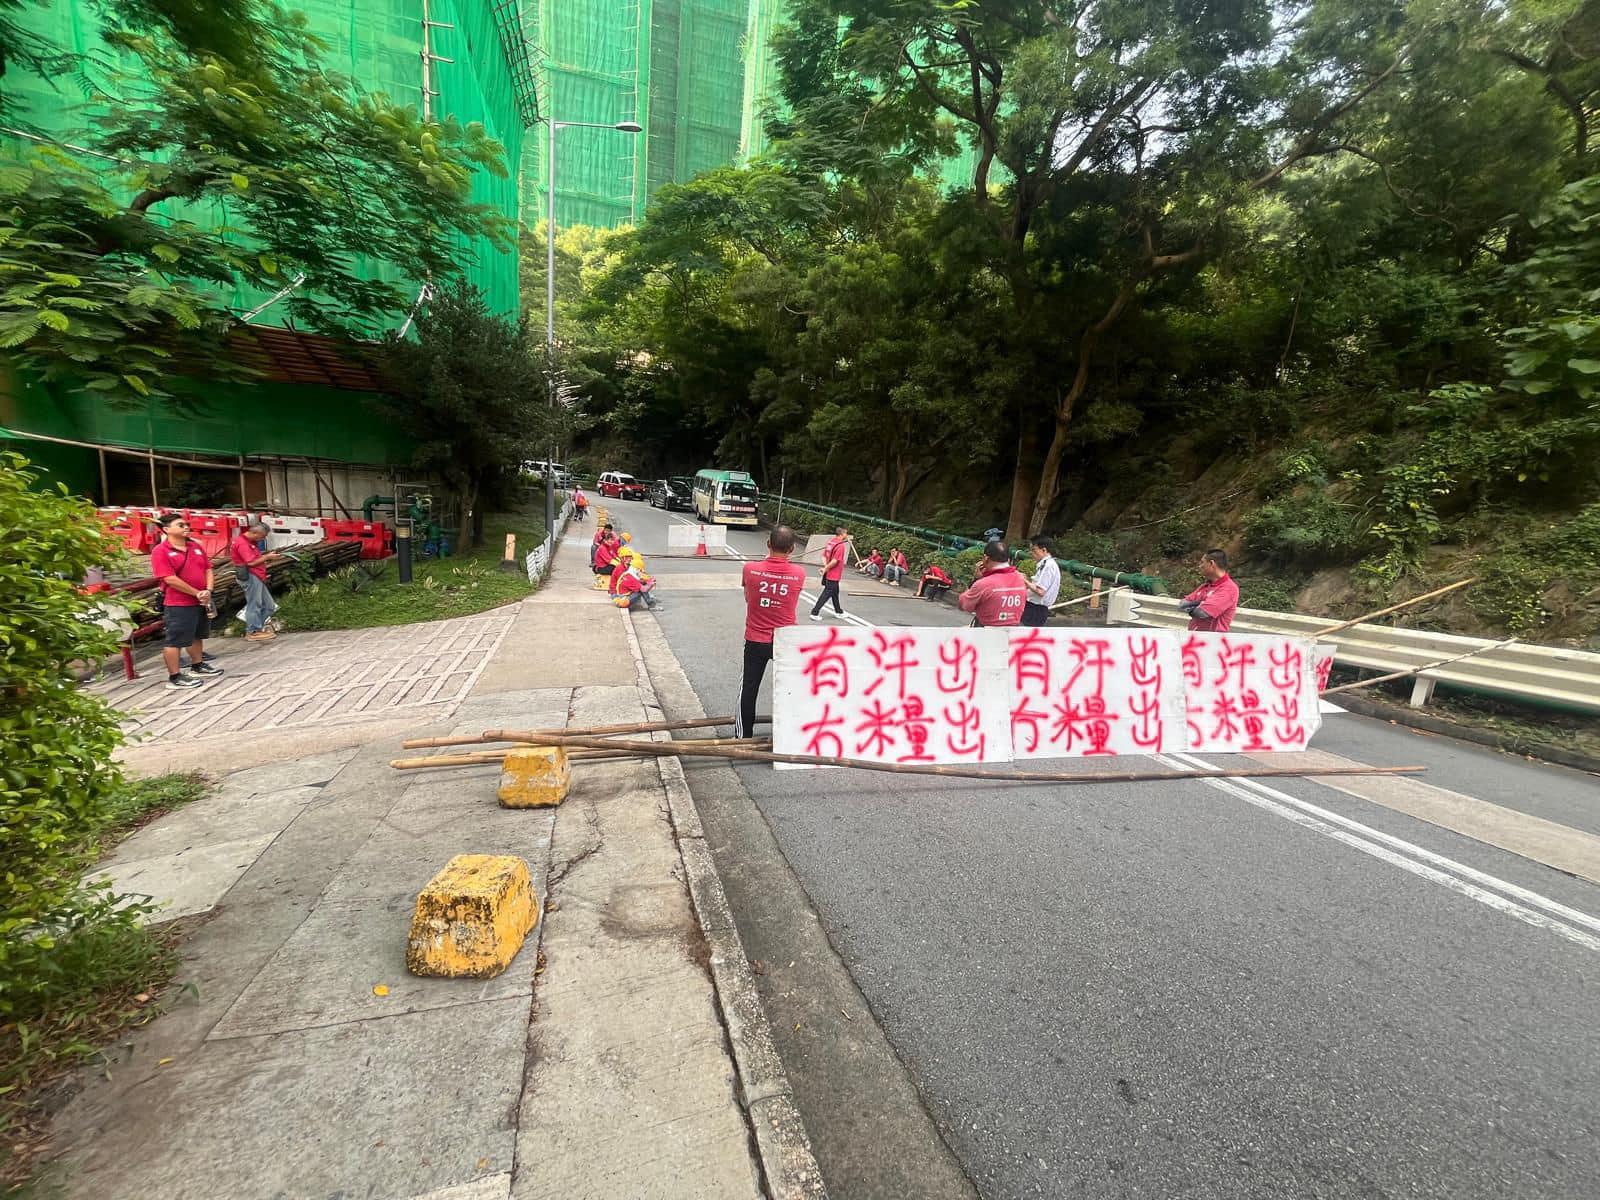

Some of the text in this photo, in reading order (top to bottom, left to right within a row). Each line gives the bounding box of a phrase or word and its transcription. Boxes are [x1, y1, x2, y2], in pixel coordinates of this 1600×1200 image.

[759, 581, 789, 596] 215
[1001, 595, 1021, 608] 706
[799, 627, 978, 700] 有汗出
[1009, 627, 1163, 697] 有汗出
